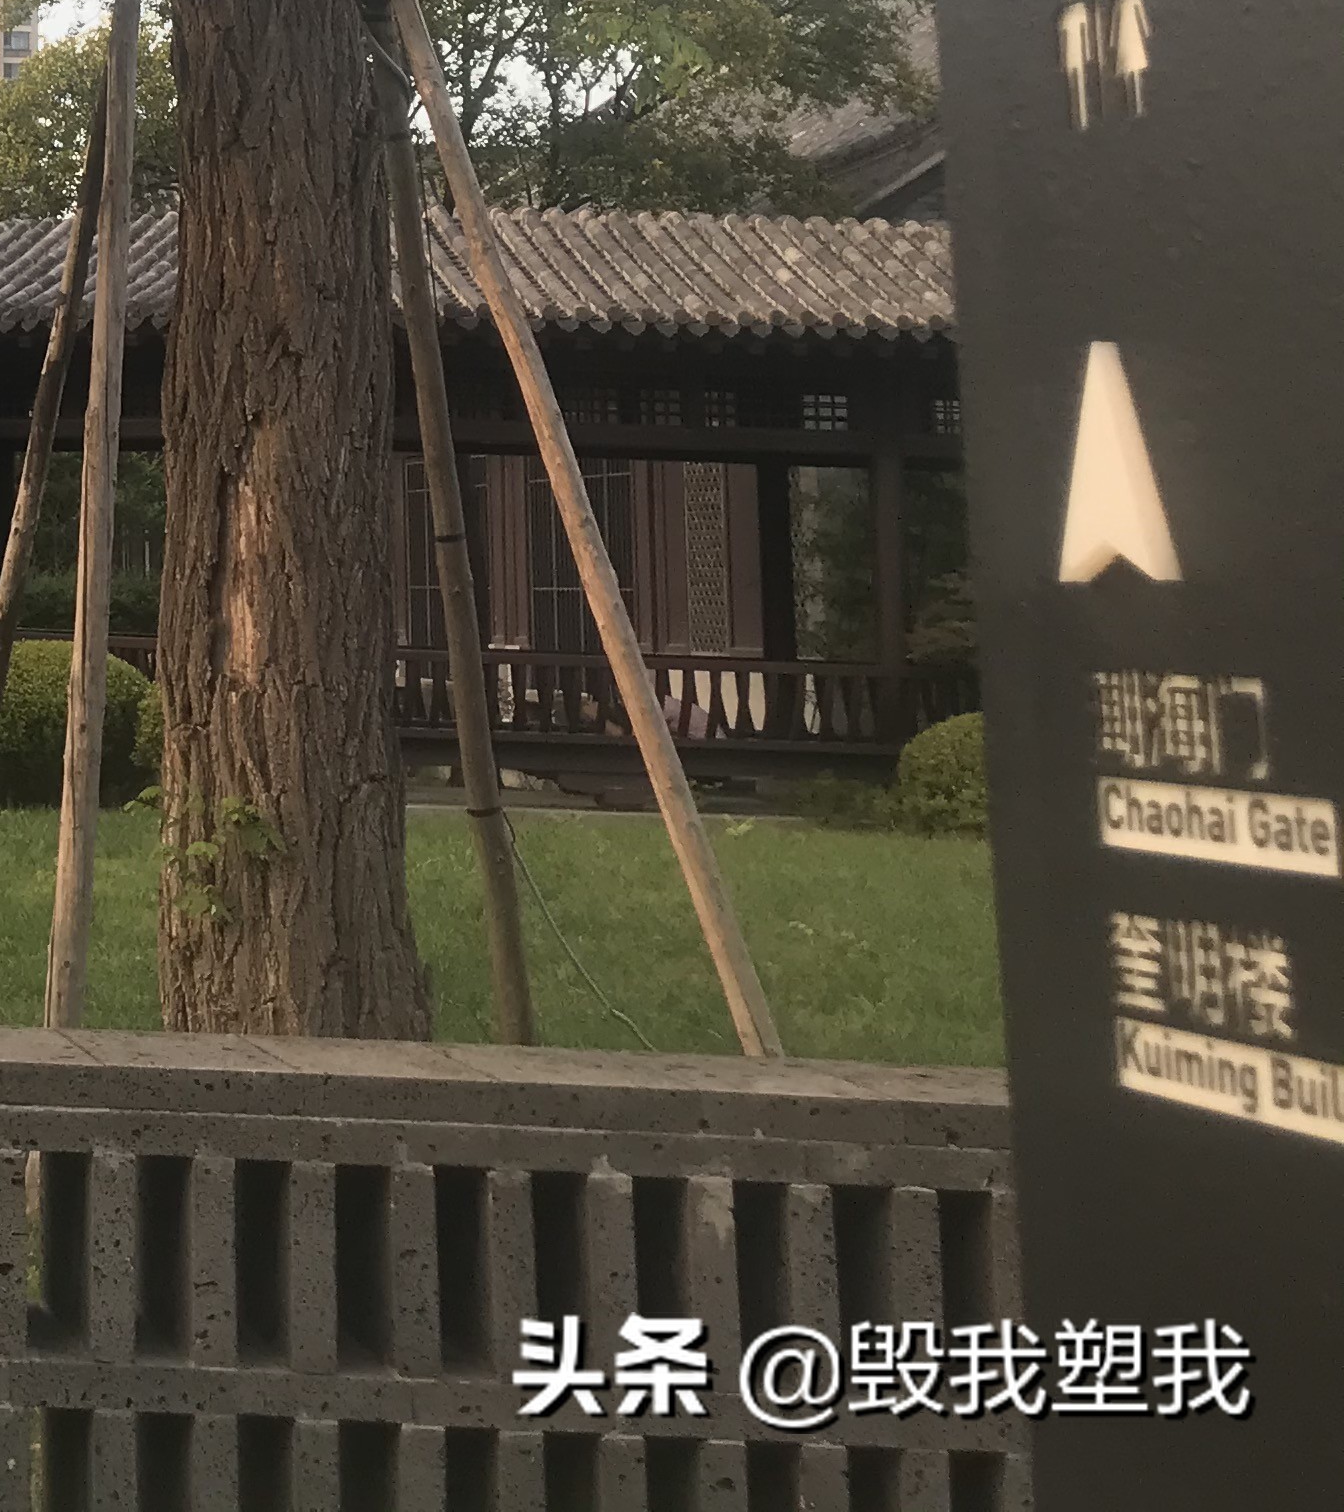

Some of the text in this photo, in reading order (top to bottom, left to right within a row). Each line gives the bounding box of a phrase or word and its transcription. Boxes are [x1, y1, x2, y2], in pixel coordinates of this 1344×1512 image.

[1102, 782, 1331, 856] Chaohai Gate
[1119, 1020, 1258, 1114] Kuiming
